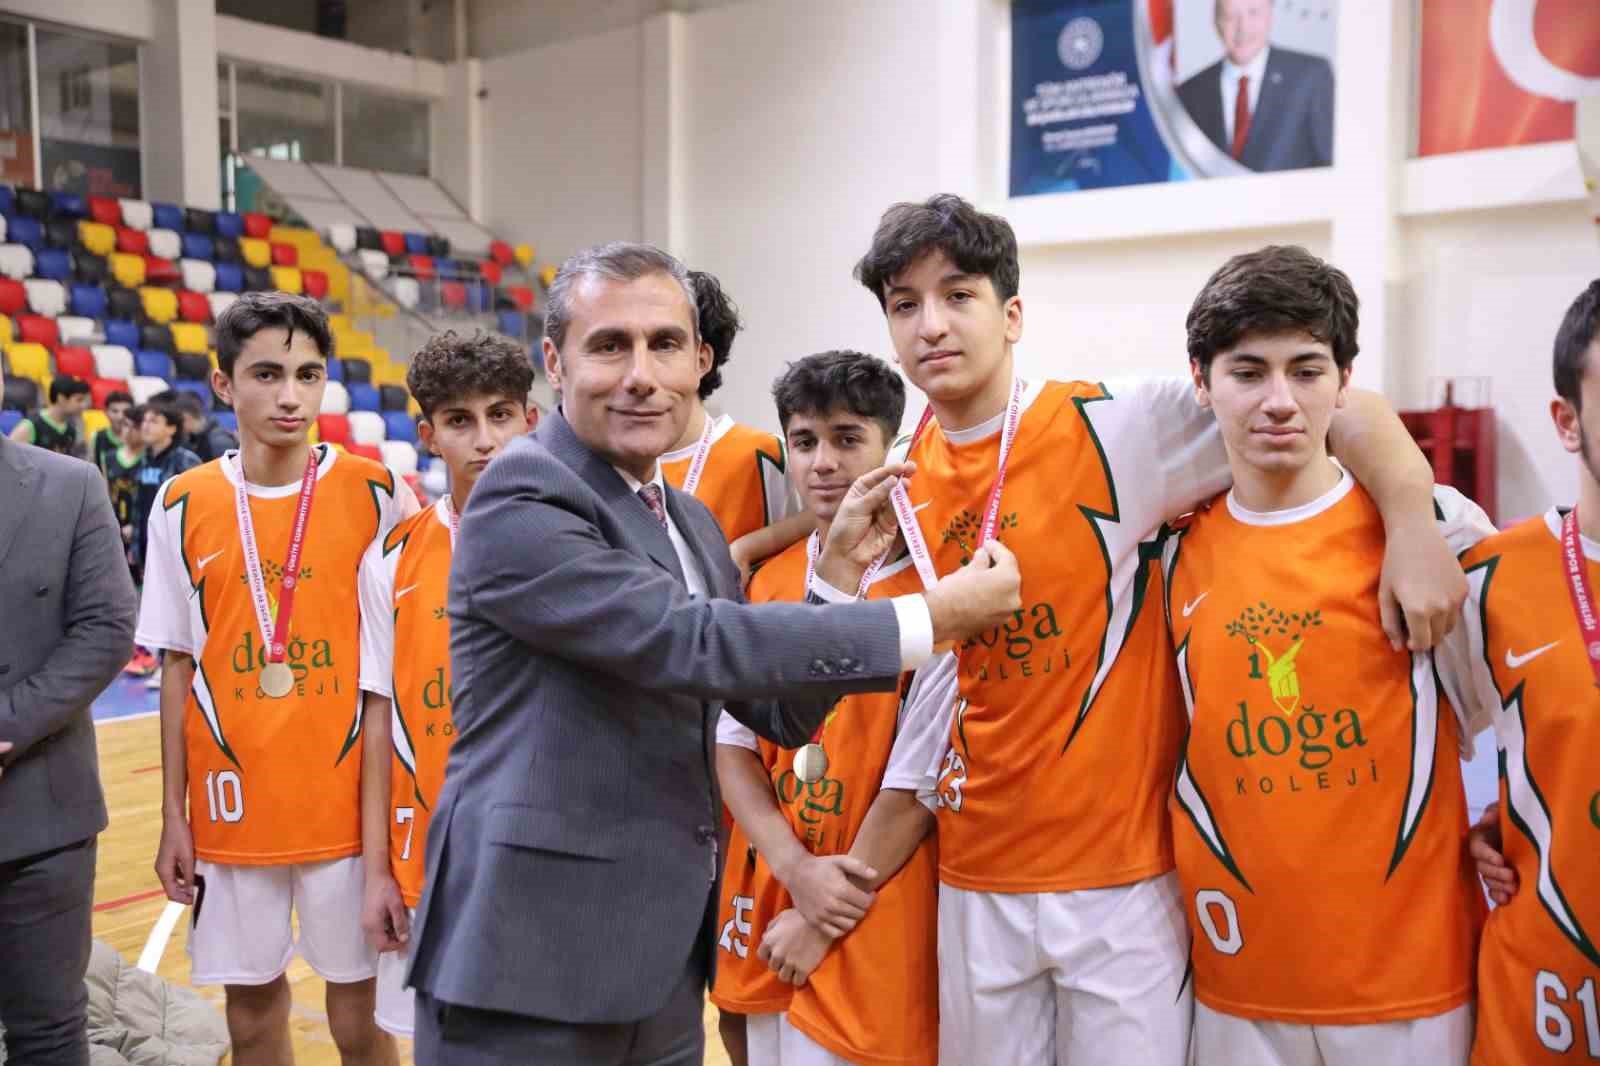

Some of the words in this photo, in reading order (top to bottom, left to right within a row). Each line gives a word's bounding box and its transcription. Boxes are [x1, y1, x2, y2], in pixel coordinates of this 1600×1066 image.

[235, 675, 340, 702] KOEJİ
[1226, 700, 1368, 770] doğa
[206, 769, 244, 823] 10
[1235, 759, 1379, 795] KOLEJİ
[396, 807, 415, 860] 7
[1195, 888, 1244, 956] 0
[1535, 969, 1600, 1060] 61
